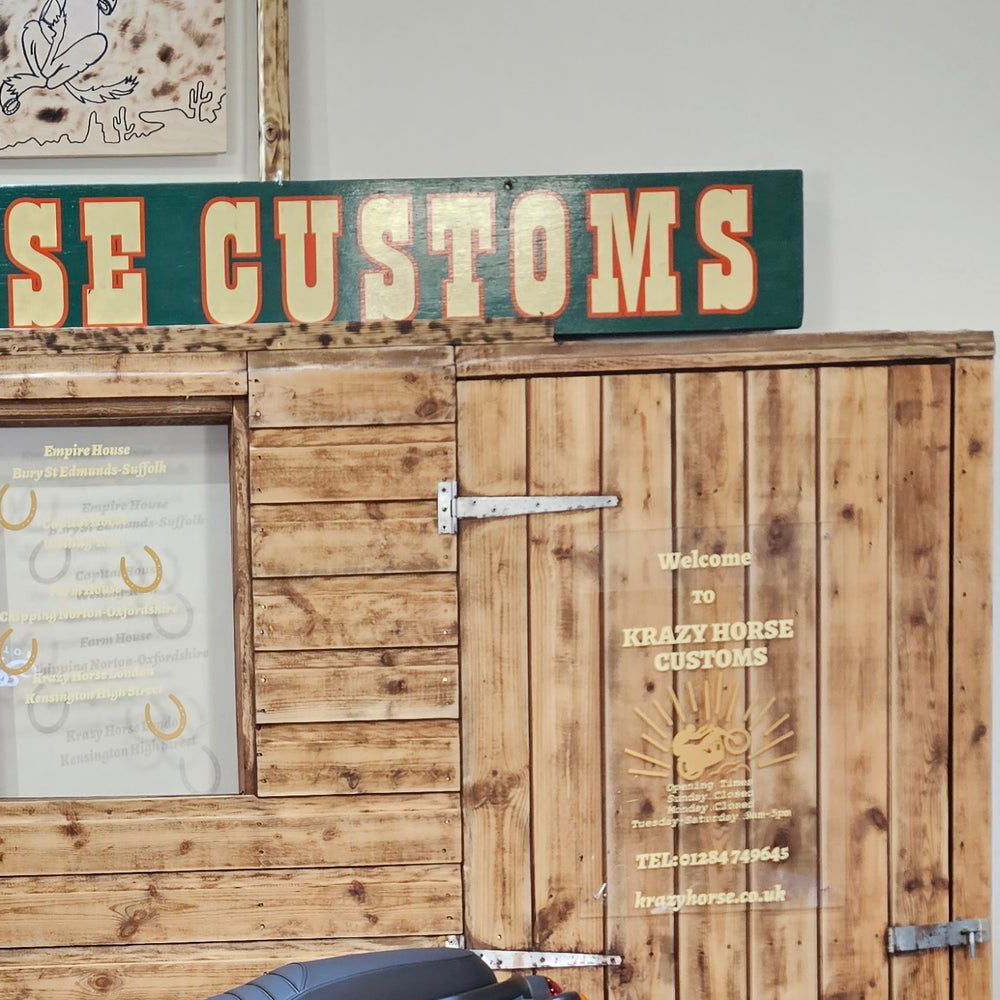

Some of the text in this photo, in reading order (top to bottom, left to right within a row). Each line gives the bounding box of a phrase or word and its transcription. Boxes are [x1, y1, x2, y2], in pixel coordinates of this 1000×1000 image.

[200, 185, 759, 325] CUSTOMS
[43, 443, 131, 459] Empire House
[12, 460, 168, 482] Bury St Edmunds-Suffolk
[657, 549, 752, 570] Welcome
[691, 589, 716, 605] TO
[622, 618, 795, 648] KRAZY HORSE
[654, 646, 769, 673] CUSTOMS
[666, 790, 753, 804] Sunday Closed
[667, 801, 754, 815] Monday Closed
[633, 884, 787, 911] krazyhorse.co.uk
